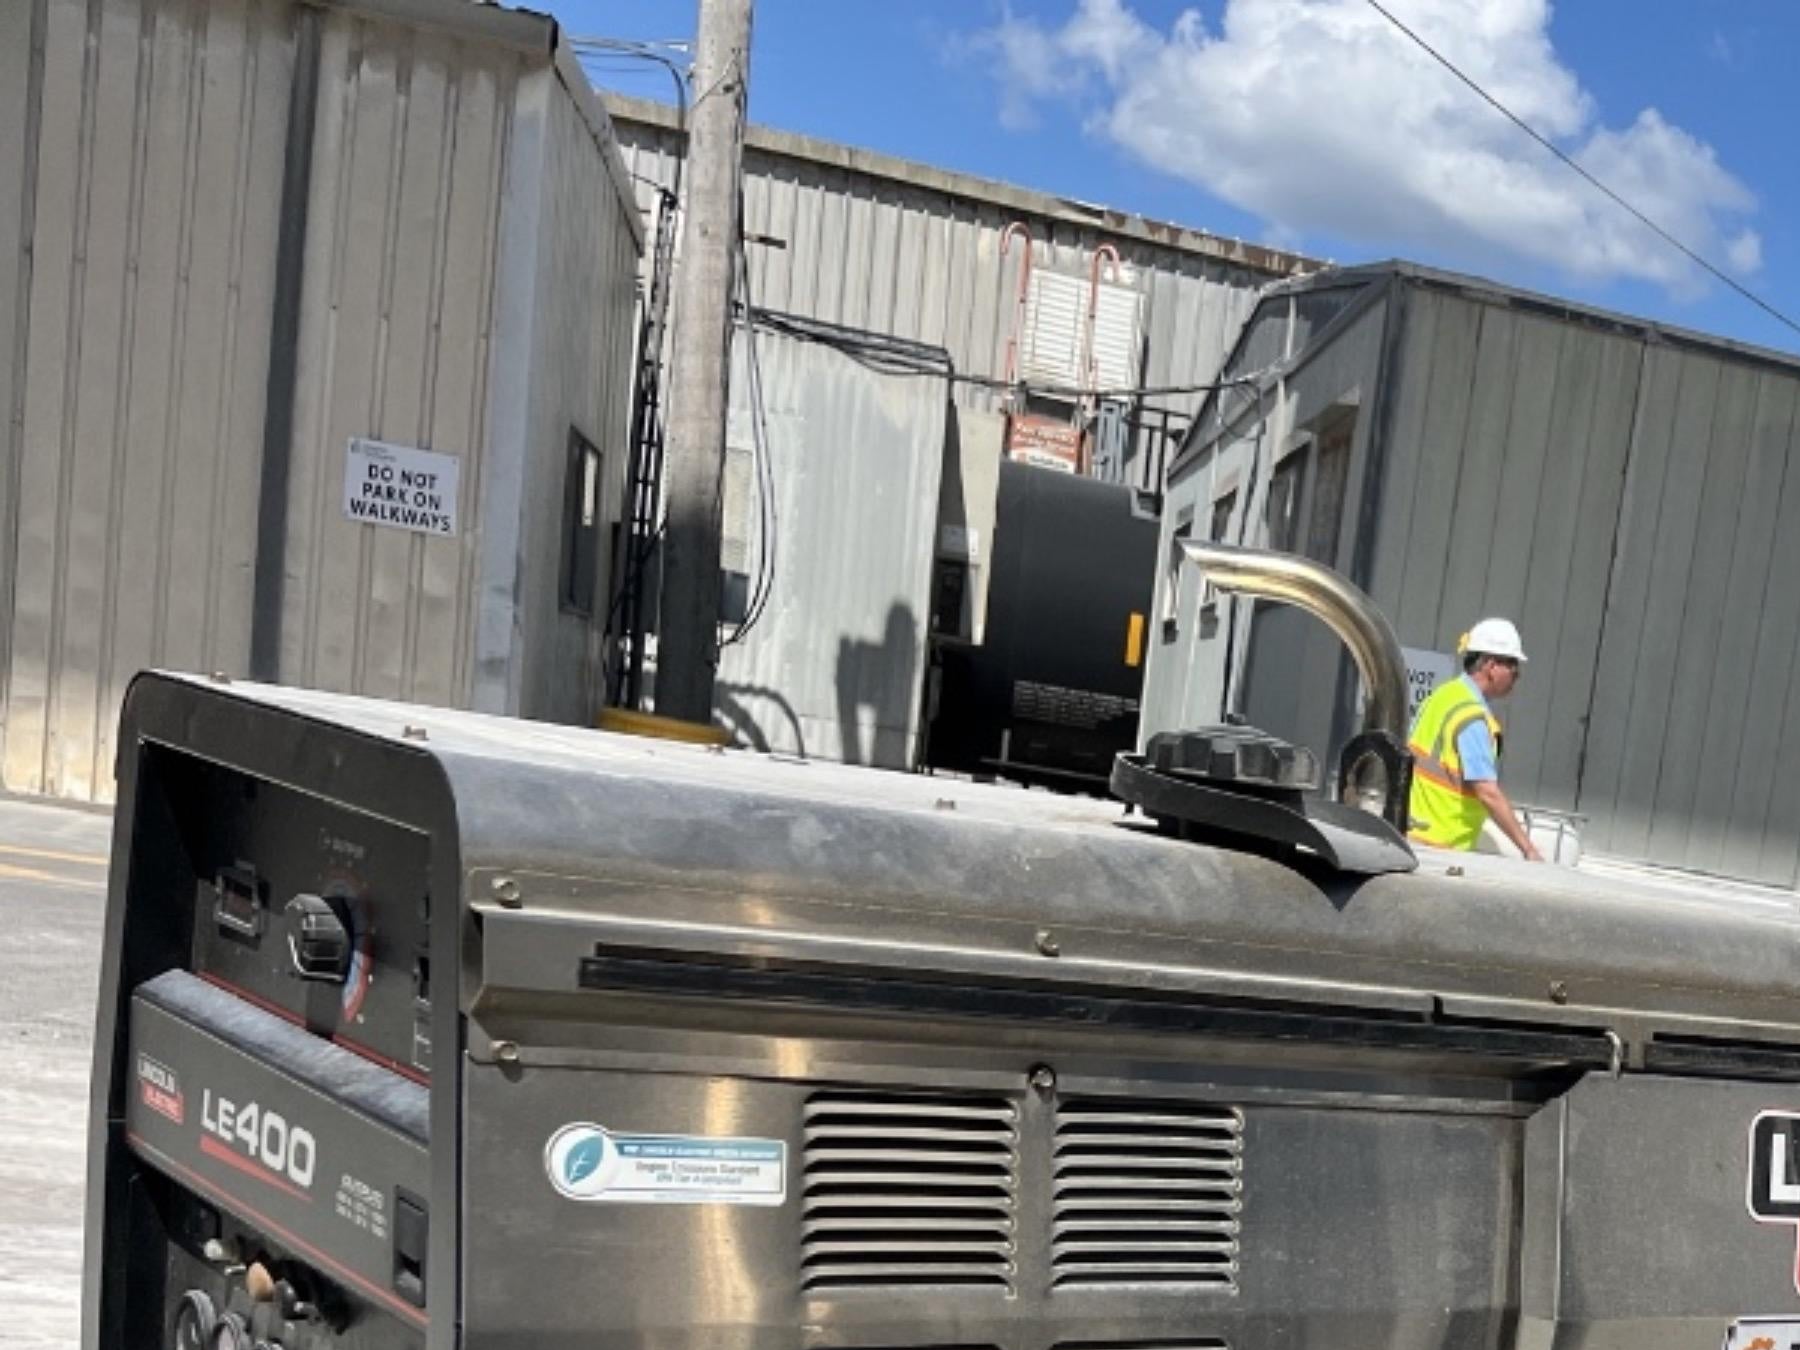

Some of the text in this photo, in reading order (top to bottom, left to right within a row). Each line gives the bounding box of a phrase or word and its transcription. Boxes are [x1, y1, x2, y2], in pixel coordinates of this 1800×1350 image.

[368, 464, 437, 489] DO NOT
[363, 482, 441, 510] PARK ON
[350, 498, 451, 531] WALKWAYS
[202, 1088, 316, 1186] LE400
